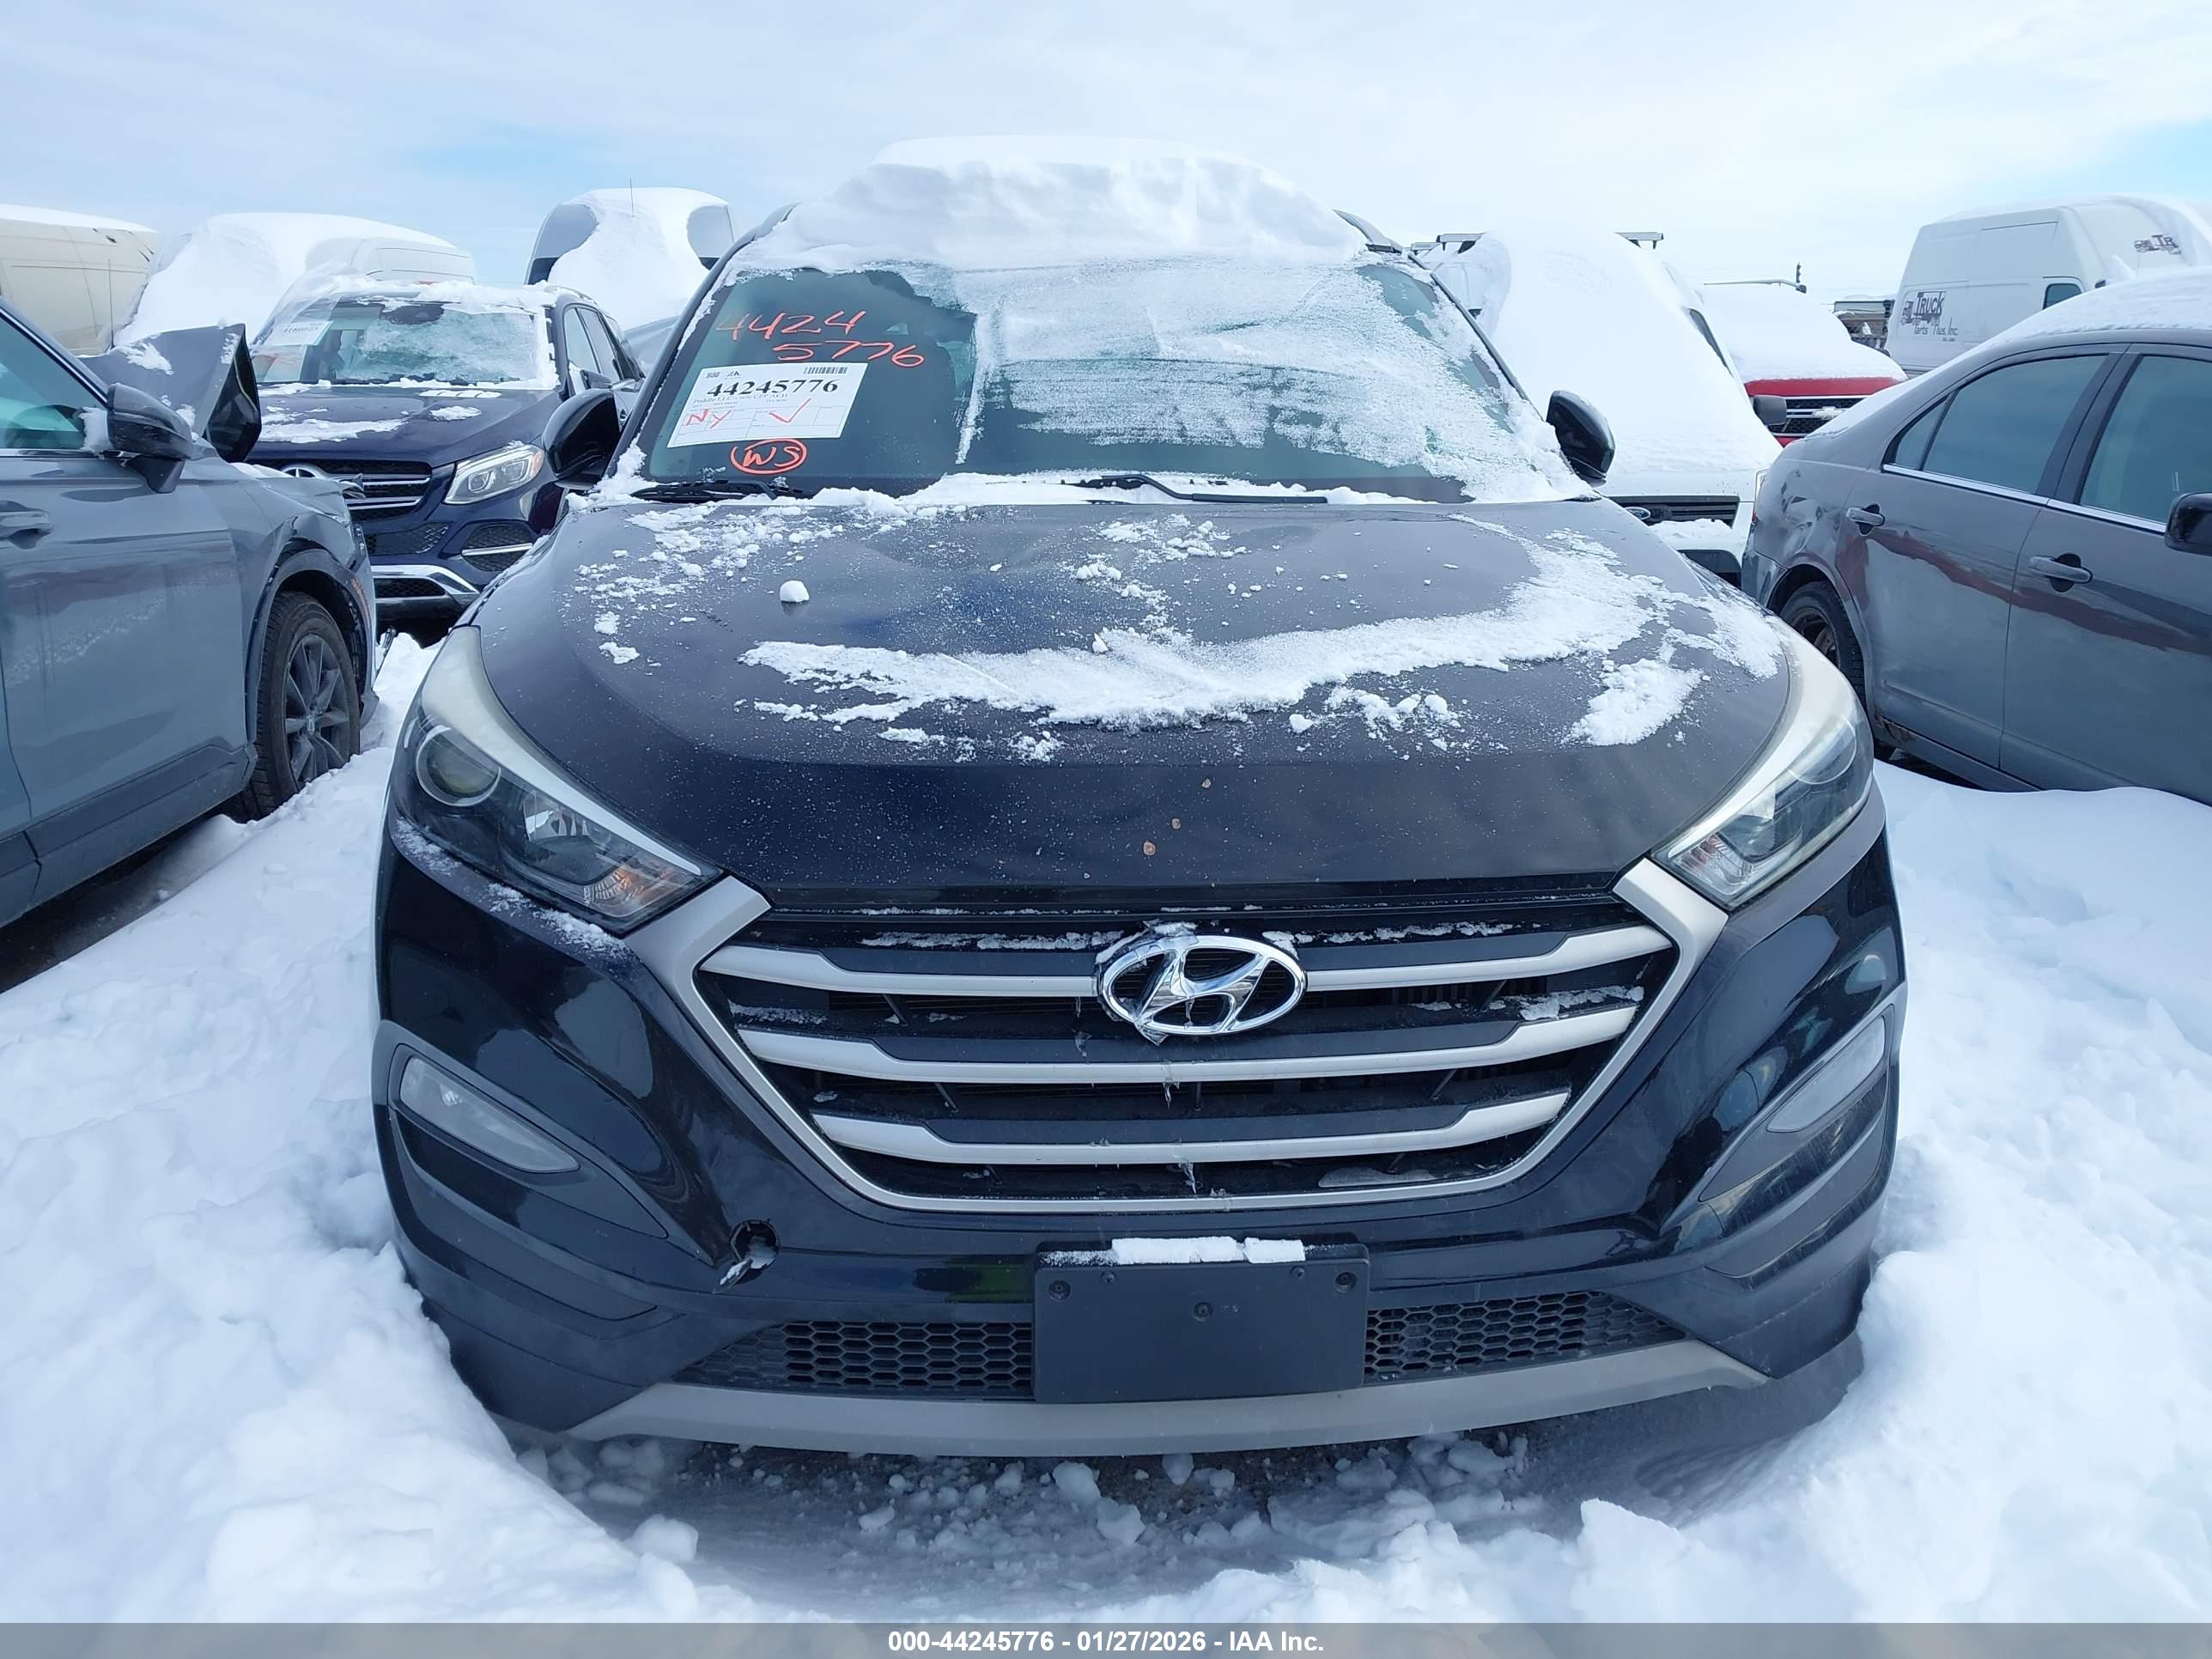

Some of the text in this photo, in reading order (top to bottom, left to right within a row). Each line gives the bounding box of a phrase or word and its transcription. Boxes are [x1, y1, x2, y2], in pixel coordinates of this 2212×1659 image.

[1916, 291, 1946, 315] TRUCK
[716, 310, 866, 341] 4424
[773, 340, 925, 368] 5776
[707, 378, 838, 396] 44245776
[686, 408, 732, 428] NY
[741, 445, 803, 469] WS
